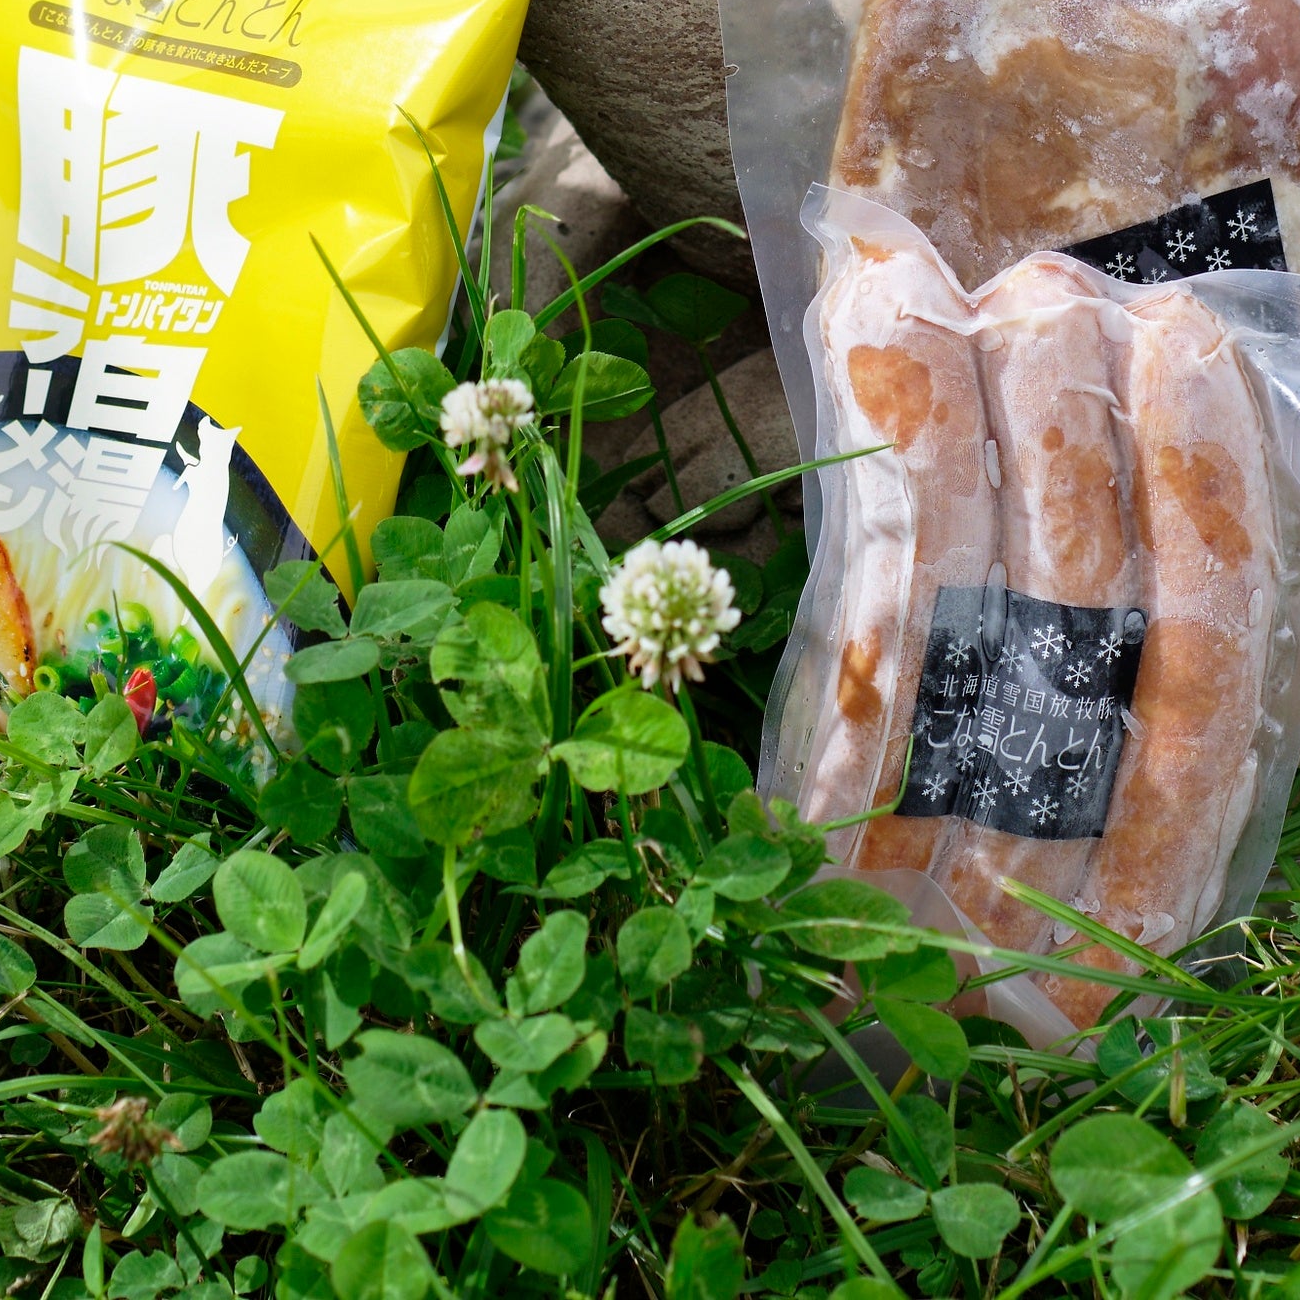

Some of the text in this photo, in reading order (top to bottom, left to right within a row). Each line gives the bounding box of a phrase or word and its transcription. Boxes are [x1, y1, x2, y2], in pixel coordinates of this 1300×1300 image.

[38, 5, 294, 81] 「こなんとん」の豚骨を贅沢に炊き込んだスープ
[94, 290, 226, 335] トンパイタン
[143, 279, 209, 297] TONPAITAN
[938, 672, 1116, 721] 北海道雪国放牧豚
[926, 703, 1103, 771] こな雪とんとん
